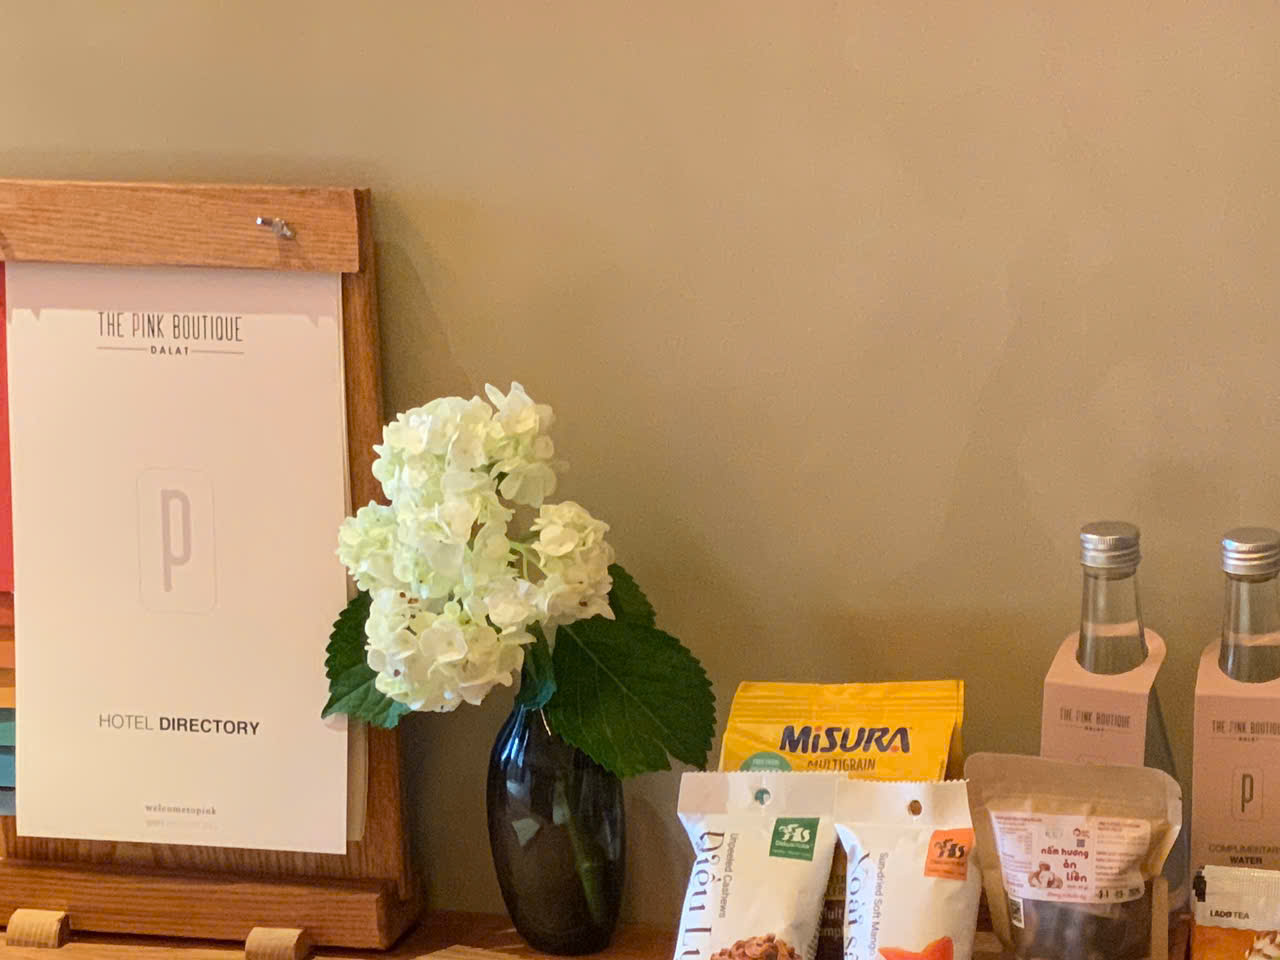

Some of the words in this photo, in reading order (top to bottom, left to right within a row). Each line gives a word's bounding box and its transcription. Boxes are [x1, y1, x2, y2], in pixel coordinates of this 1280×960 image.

[98, 311, 125, 338] THE
[132, 312, 165, 339] PINK
[172, 314, 244, 342] BOUTIQUE
[149, 345, 189, 356] DALAT
[98, 713, 154, 731] HOTEL
[159, 716, 260, 736] DIRECTORY
[807, 757, 877, 773] MULTIGRAIN
[1229, 856, 1263, 865] WATER
[718, 874, 734, 920] Cashews
[1234, 911, 1250, 920] TEA
